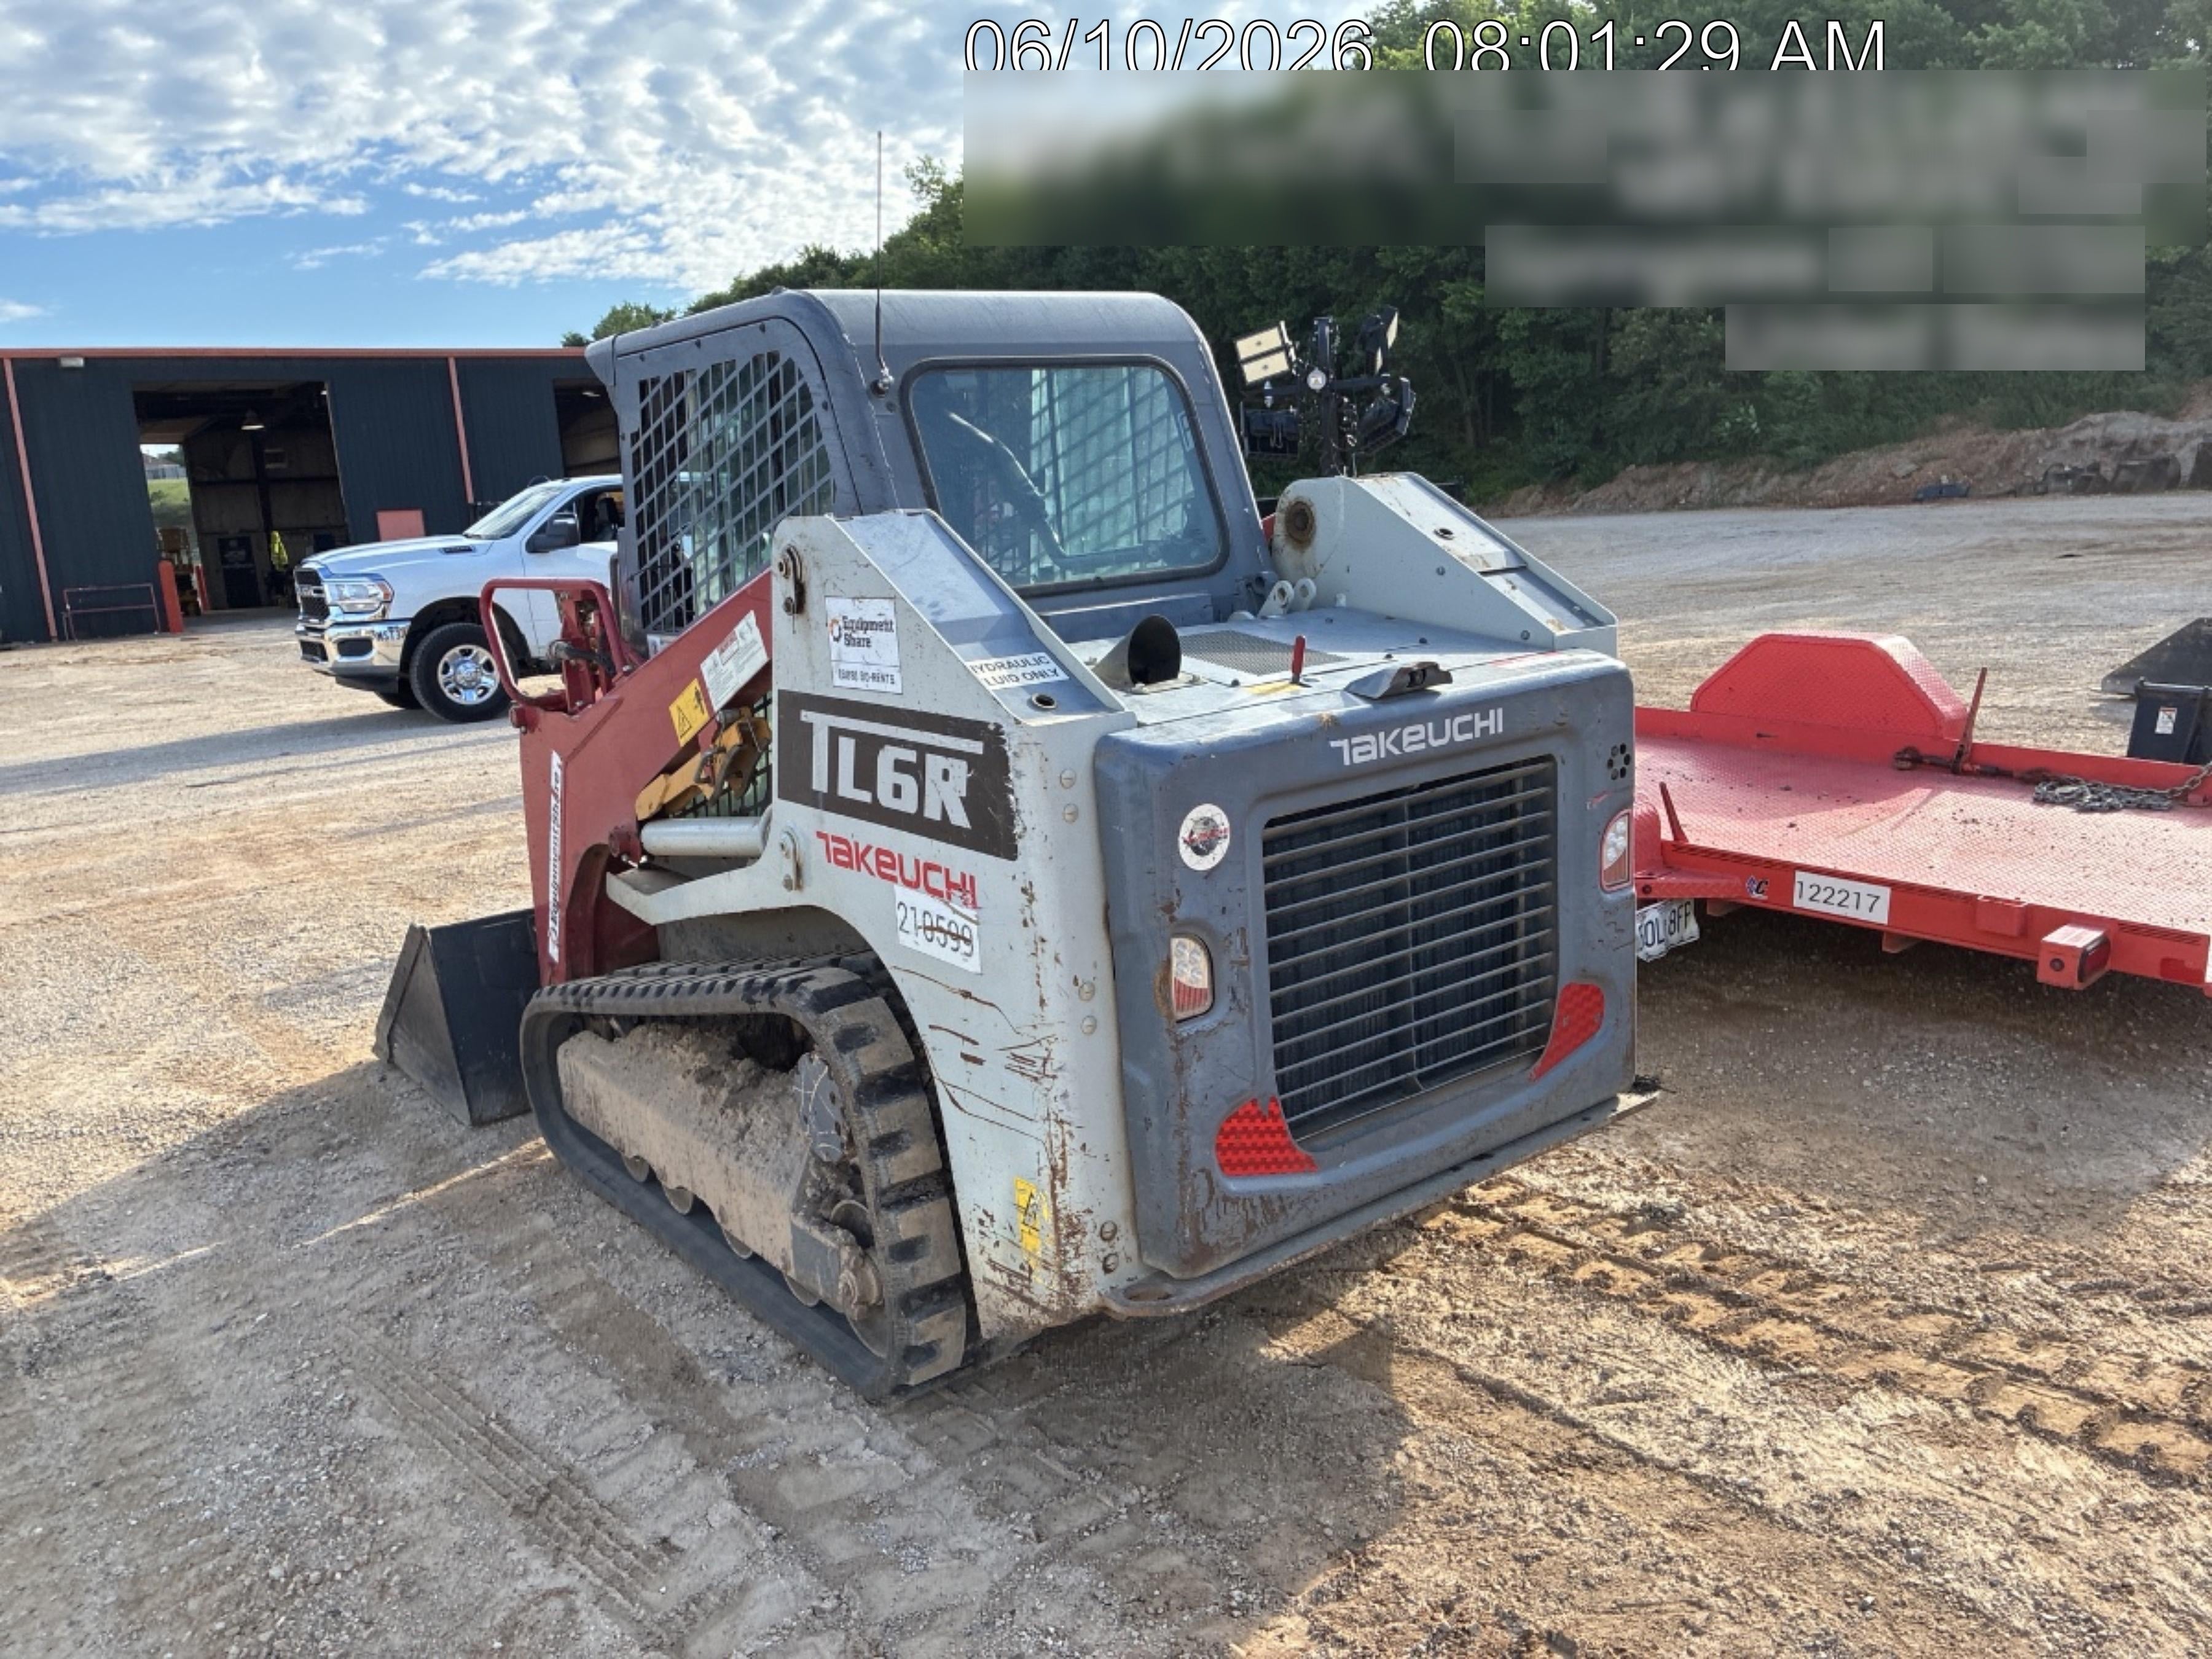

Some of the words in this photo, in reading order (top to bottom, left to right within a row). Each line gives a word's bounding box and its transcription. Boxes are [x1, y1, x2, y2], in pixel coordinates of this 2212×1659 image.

[842, 616, 895, 635] Equipment
[844, 633, 872, 648] Share
[1021, 668, 1059, 680] ONLY
[1329, 707, 1504, 766] TAKEUCHI
[799, 710, 984, 830] TL6R
[816, 831, 978, 909] TAKEUCHI
[1797, 880, 1881, 913] 122217
[897, 901, 974, 957] 210599
